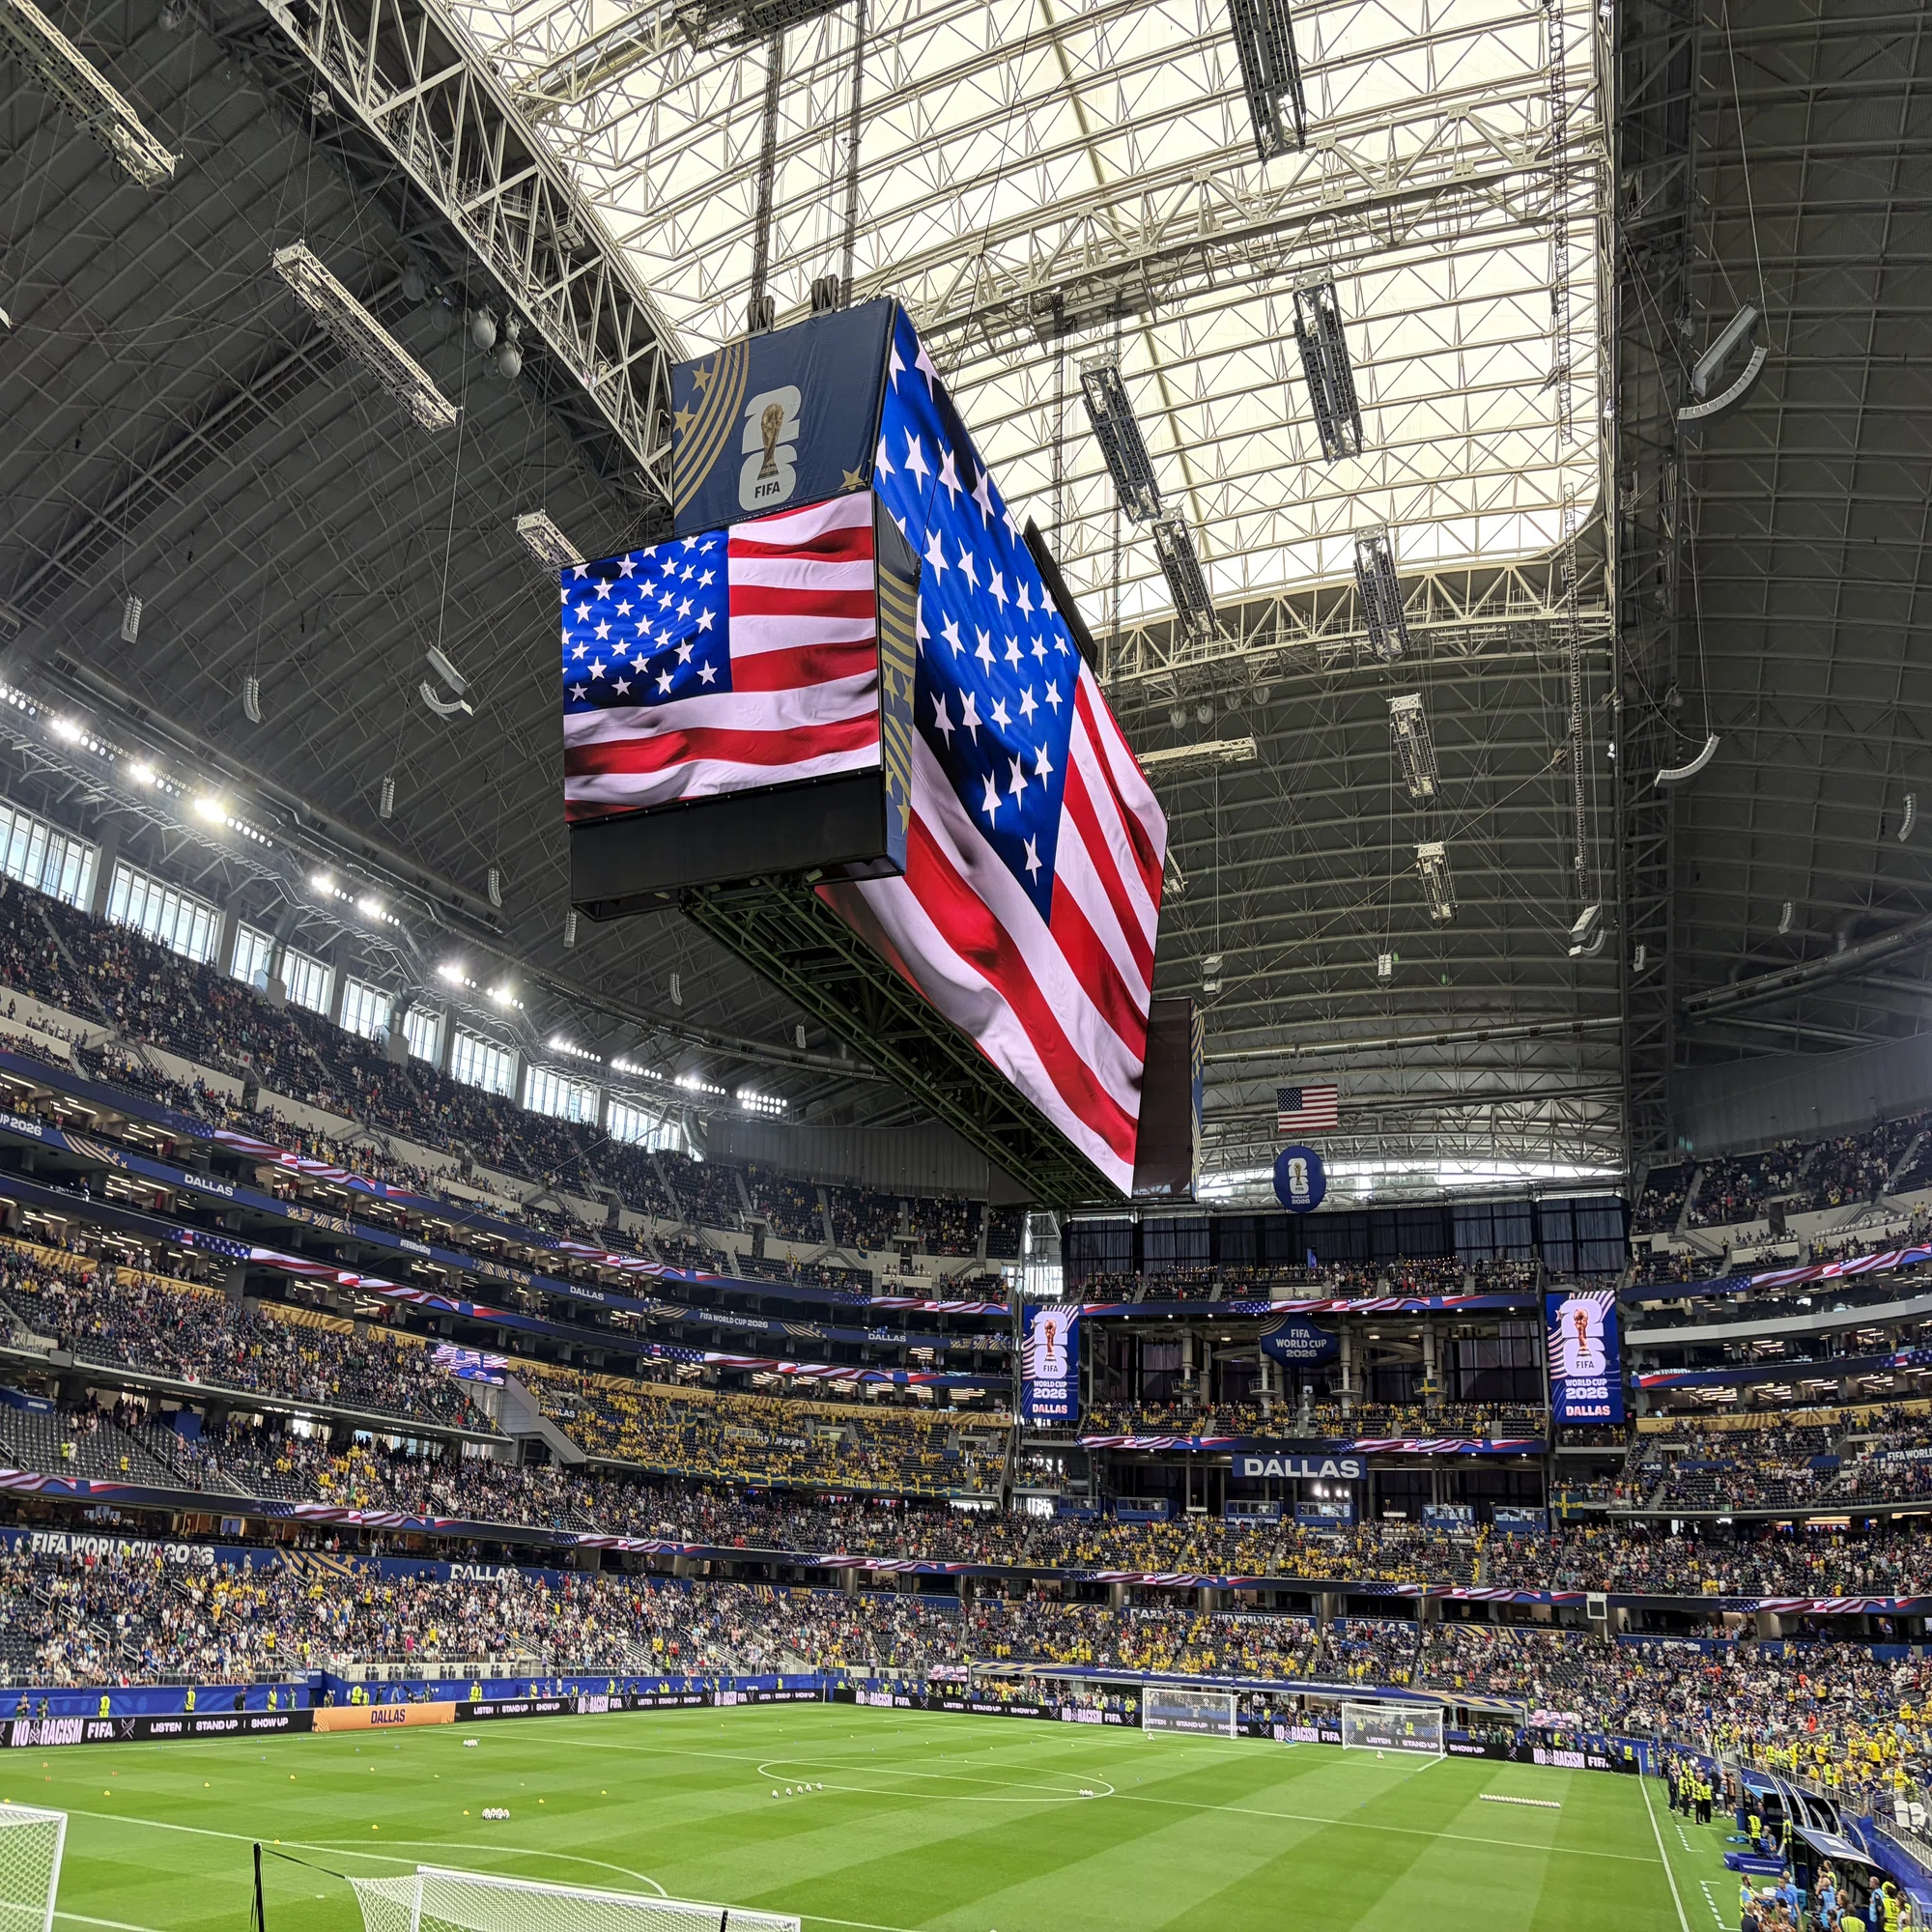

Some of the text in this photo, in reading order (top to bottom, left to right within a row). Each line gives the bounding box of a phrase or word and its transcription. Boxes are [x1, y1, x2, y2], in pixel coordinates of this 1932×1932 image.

[754, 481, 781, 498] FIFA
[10, 1118, 43, 1137] 2026
[184, 1173, 234, 1197] DALLAS
[569, 1285, 605, 1301] DALLAS
[699, 1312, 713, 1321] FIFA
[713, 1314, 734, 1324] WORLD
[747, 1320, 769, 1329] 2026
[868, 1333, 907, 1343] DALLAS
[1291, 1328, 1310, 1339] FIFA
[1275, 1338, 1327, 1349] WORLD CUP
[1286, 1350, 1318, 1358] 2026
[1043, 1364, 1059, 1373] FIFA
[1576, 1360, 1595, 1369] FIFA
[1565, 1378, 1591, 1387] WORLD
[1033, 1388, 1067, 1400] 2026
[1565, 1387, 1609, 1400] 2026
[1032, 1404, 1068, 1414] DALLAS
[1566, 1405, 1610, 1417] DALLAS
[1887, 1450, 1906, 1461] FIFA
[1244, 1458, 1360, 1478] DALLAS
[31, 1533, 67, 1553] FIFA
[577, 1695, 622, 1715] NO RACISM FIFA
[856, 1690, 911, 1707] NO RACISM FIFA
[371, 1709, 406, 1724] DALLAS
[473, 1705, 494, 1716] LISTEN
[501, 1704, 519, 1713] STAND
[1062, 1707, 1122, 1723] NO RACISM FIFA
[11, 1718, 113, 1747] NO RACISM FIFA
[151, 1718, 289, 1733] LISTEN STAND UP SHOW UP
[1273, 1724, 1341, 1743] NO RACISM FIFA
[1366, 1736, 1391, 1746] LISTEN
[1402, 1739, 1427, 1748] STAND
[1449, 1744, 1474, 1752] SHOW
[1532, 1747, 1546, 1764] NO
[1552, 1749, 1585, 1769] RACISM
